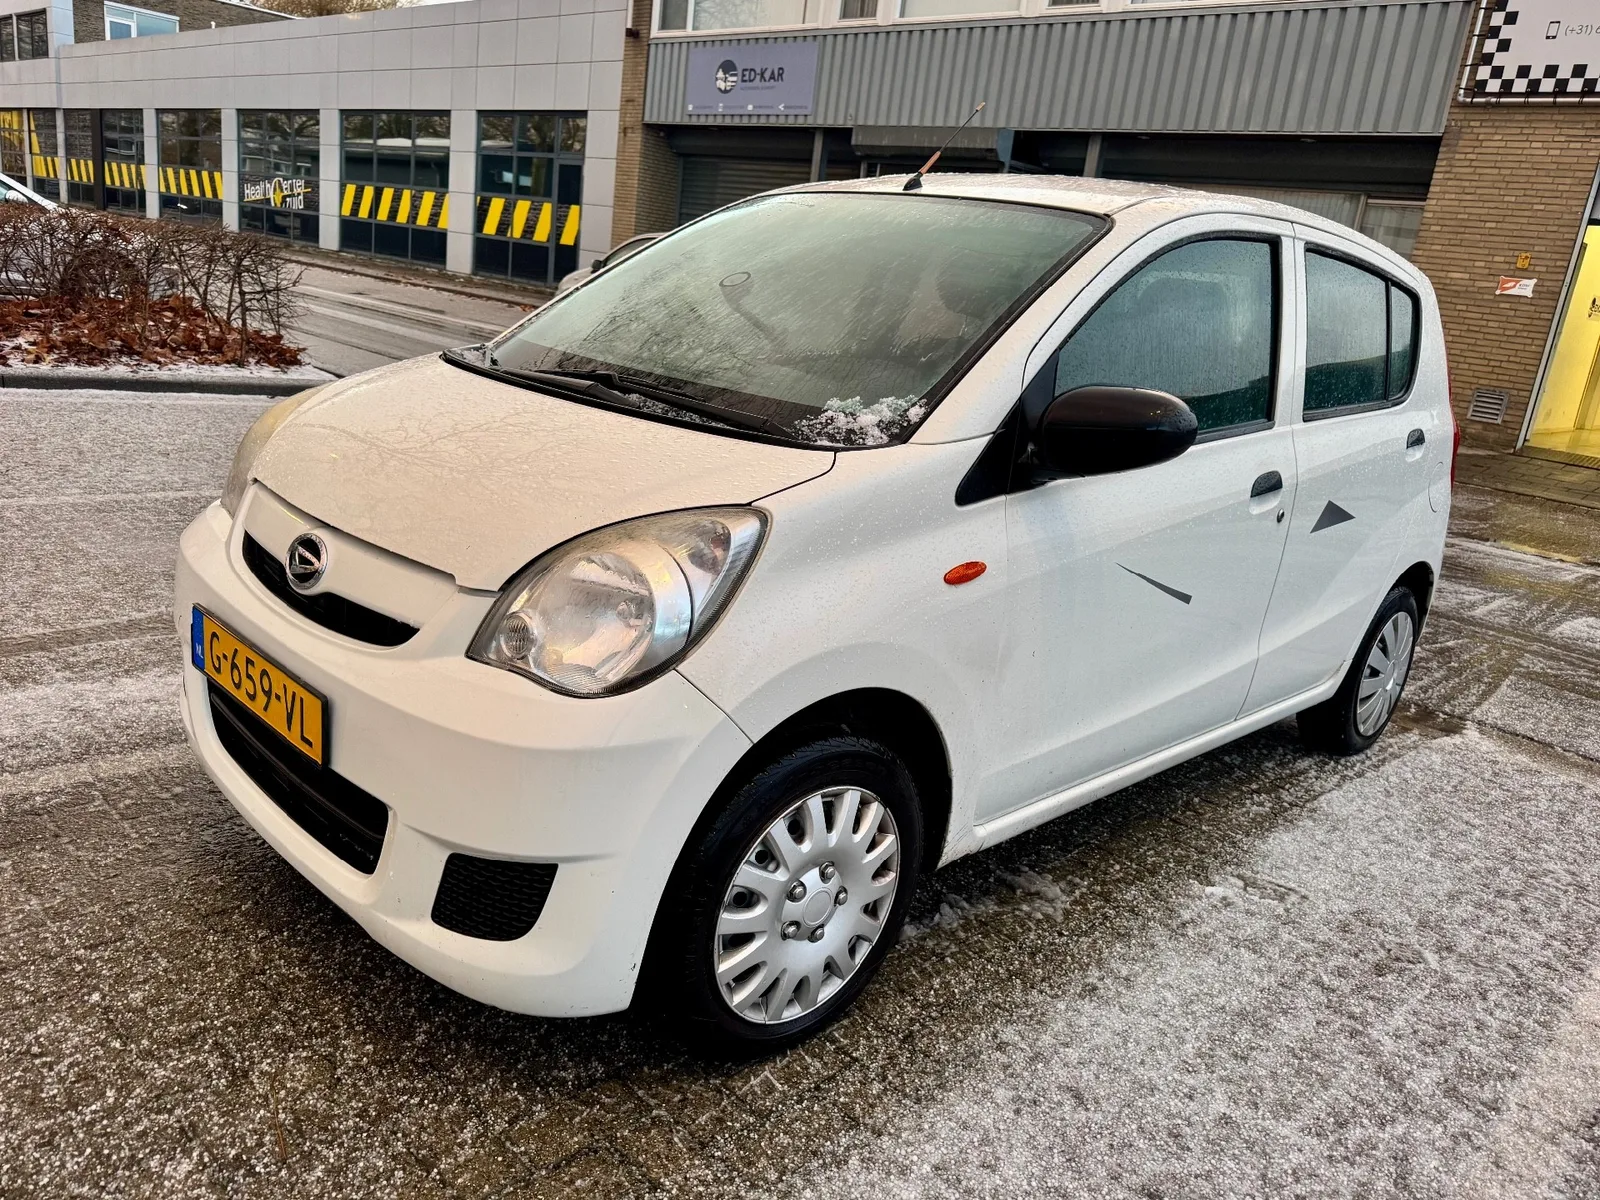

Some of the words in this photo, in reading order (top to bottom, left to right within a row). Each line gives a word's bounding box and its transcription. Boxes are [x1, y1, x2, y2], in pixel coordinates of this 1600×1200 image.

[1564, 24, 1593, 36] (+31)
[741, 67, 785, 83] ED-KAR
[209, 631, 313, 748] G-659-VL
